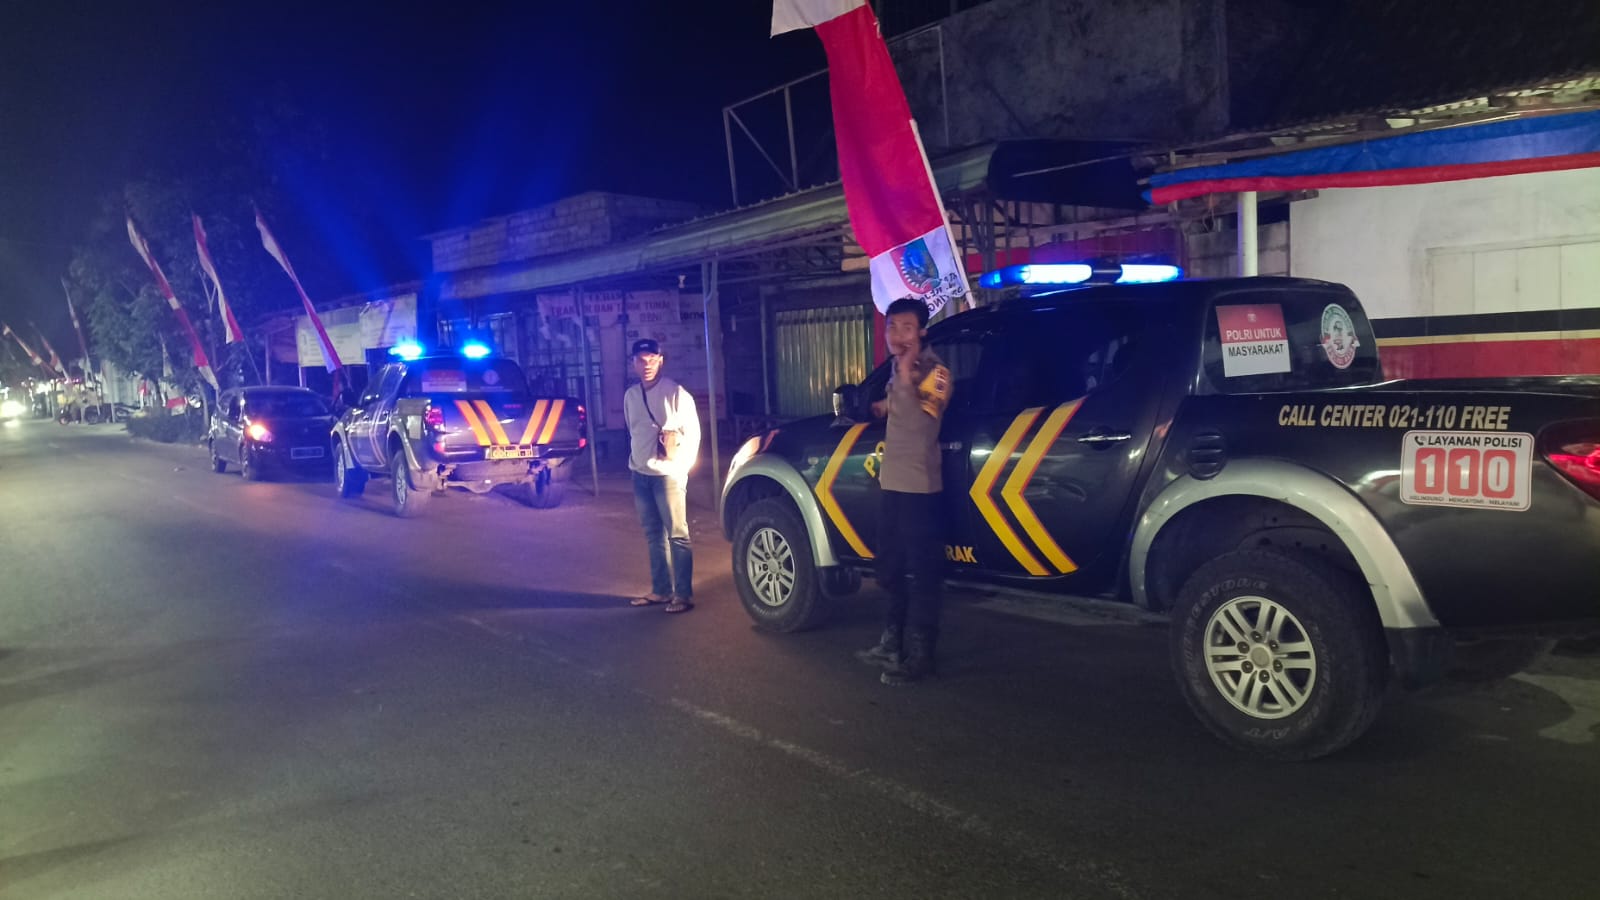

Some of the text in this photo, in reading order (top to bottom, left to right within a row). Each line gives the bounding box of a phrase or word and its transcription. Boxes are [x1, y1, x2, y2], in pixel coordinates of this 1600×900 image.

[1226, 327, 1282, 341] POLRI UNTUK
[1228, 343, 1284, 357] MASYARAKAT
[1278, 405, 1511, 430] CALL CENTER 021-110 FREE
[1428, 436, 1522, 448] LAYANAN POLISI
[1421, 453, 1510, 493] 110
